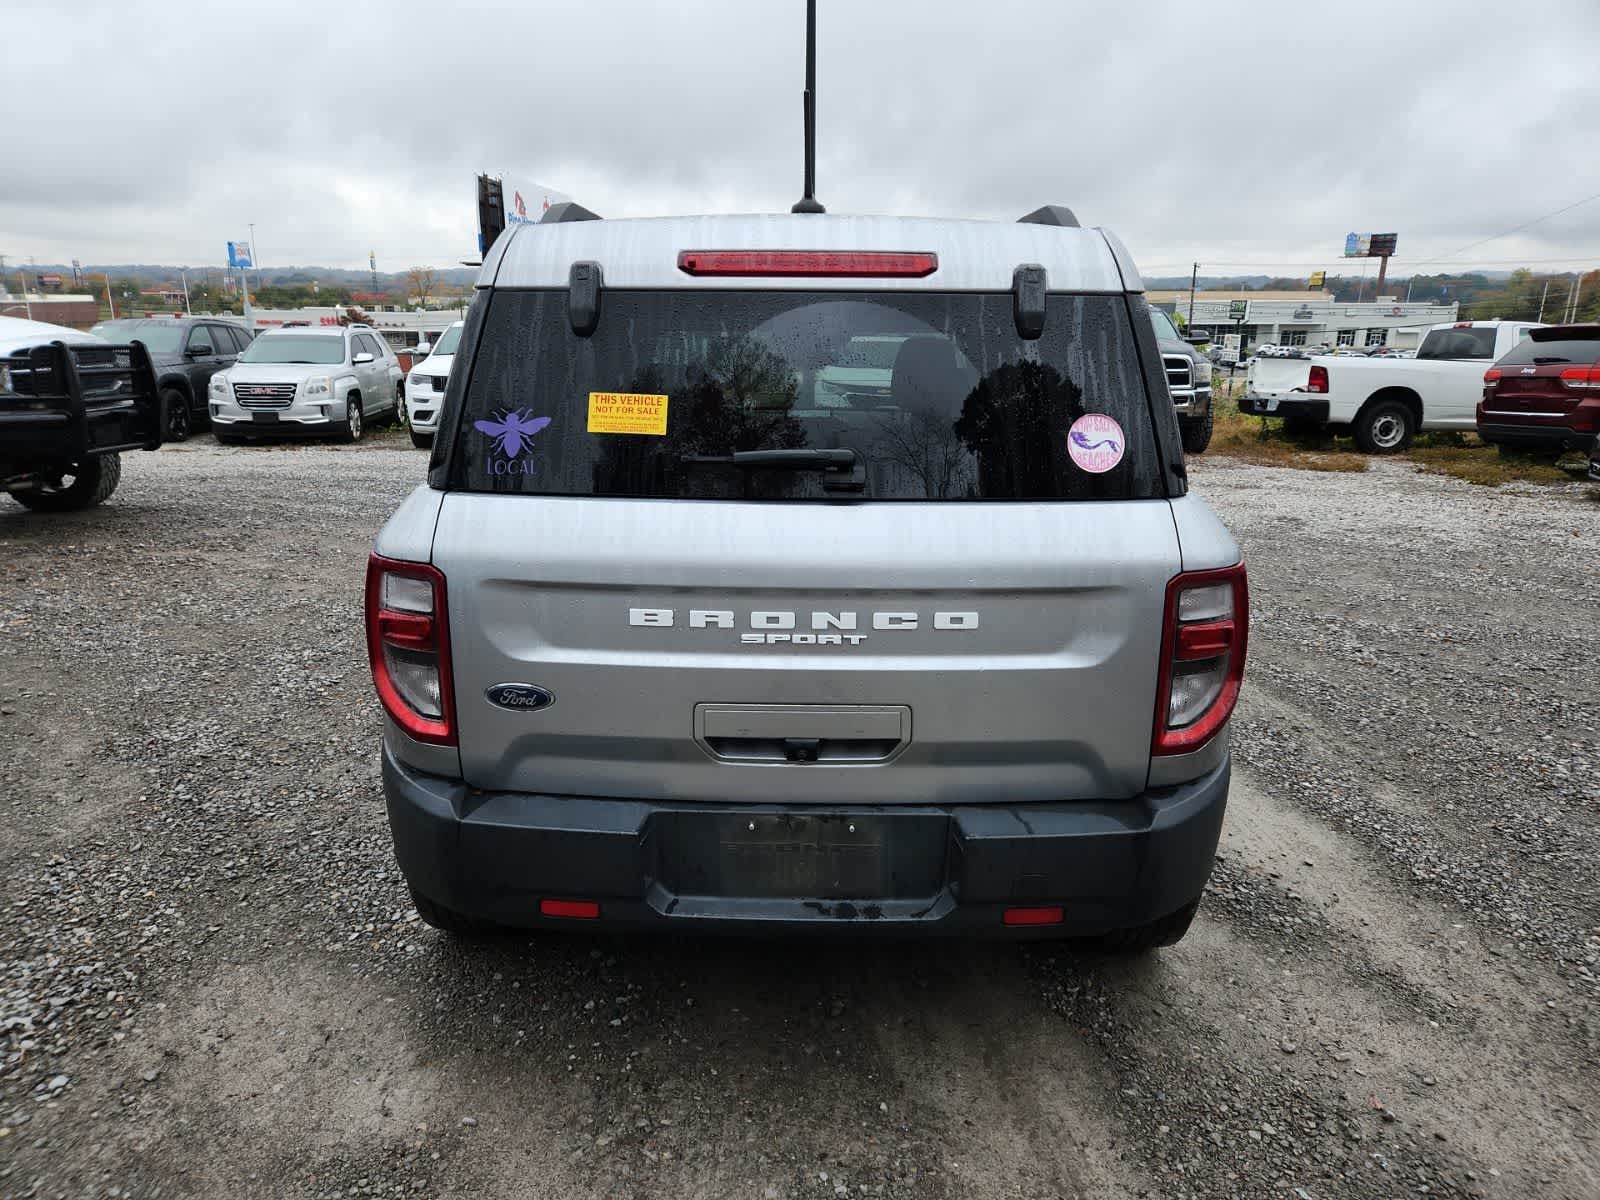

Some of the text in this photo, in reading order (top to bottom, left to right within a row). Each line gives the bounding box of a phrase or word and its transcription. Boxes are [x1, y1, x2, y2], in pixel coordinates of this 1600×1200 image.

[249, 387, 278, 395] GMC
[594, 395, 663, 406] THIS VEHICLE
[595, 406, 660, 415] NOT FOR SALE
[487, 457, 537, 475] LOCAL
[629, 607, 979, 630] BRONCO
[740, 633, 867, 646] SPORT
[499, 689, 536, 707] Ford
